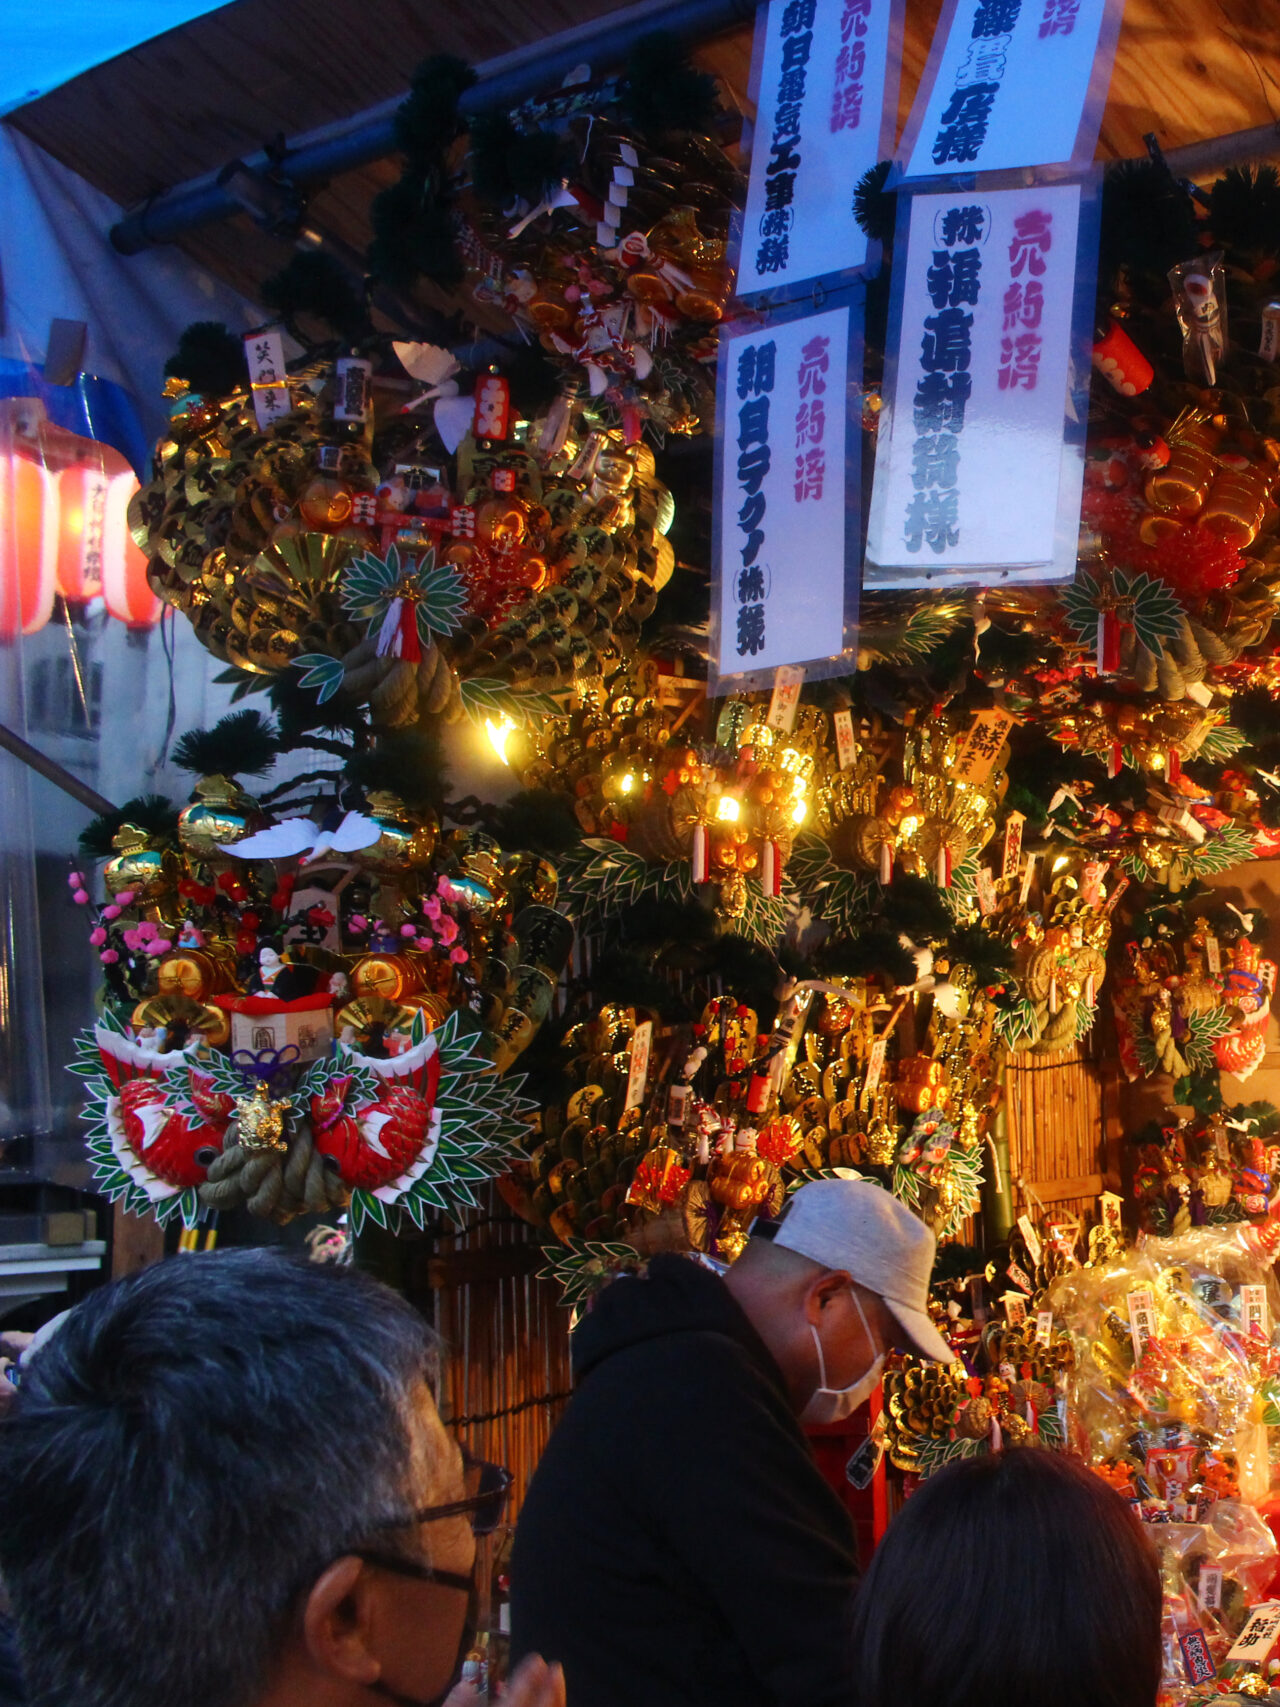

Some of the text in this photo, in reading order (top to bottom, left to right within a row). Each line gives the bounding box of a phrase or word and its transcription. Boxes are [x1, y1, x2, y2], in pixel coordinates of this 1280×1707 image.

[829, 0, 872, 134] 売約済
[254, 340, 281, 426] 笑門来
[997, 209, 1053, 392] 売約済
[734, 340, 776, 658] 朝日テクノ(株)様
[793, 335, 832, 503] 売約済
